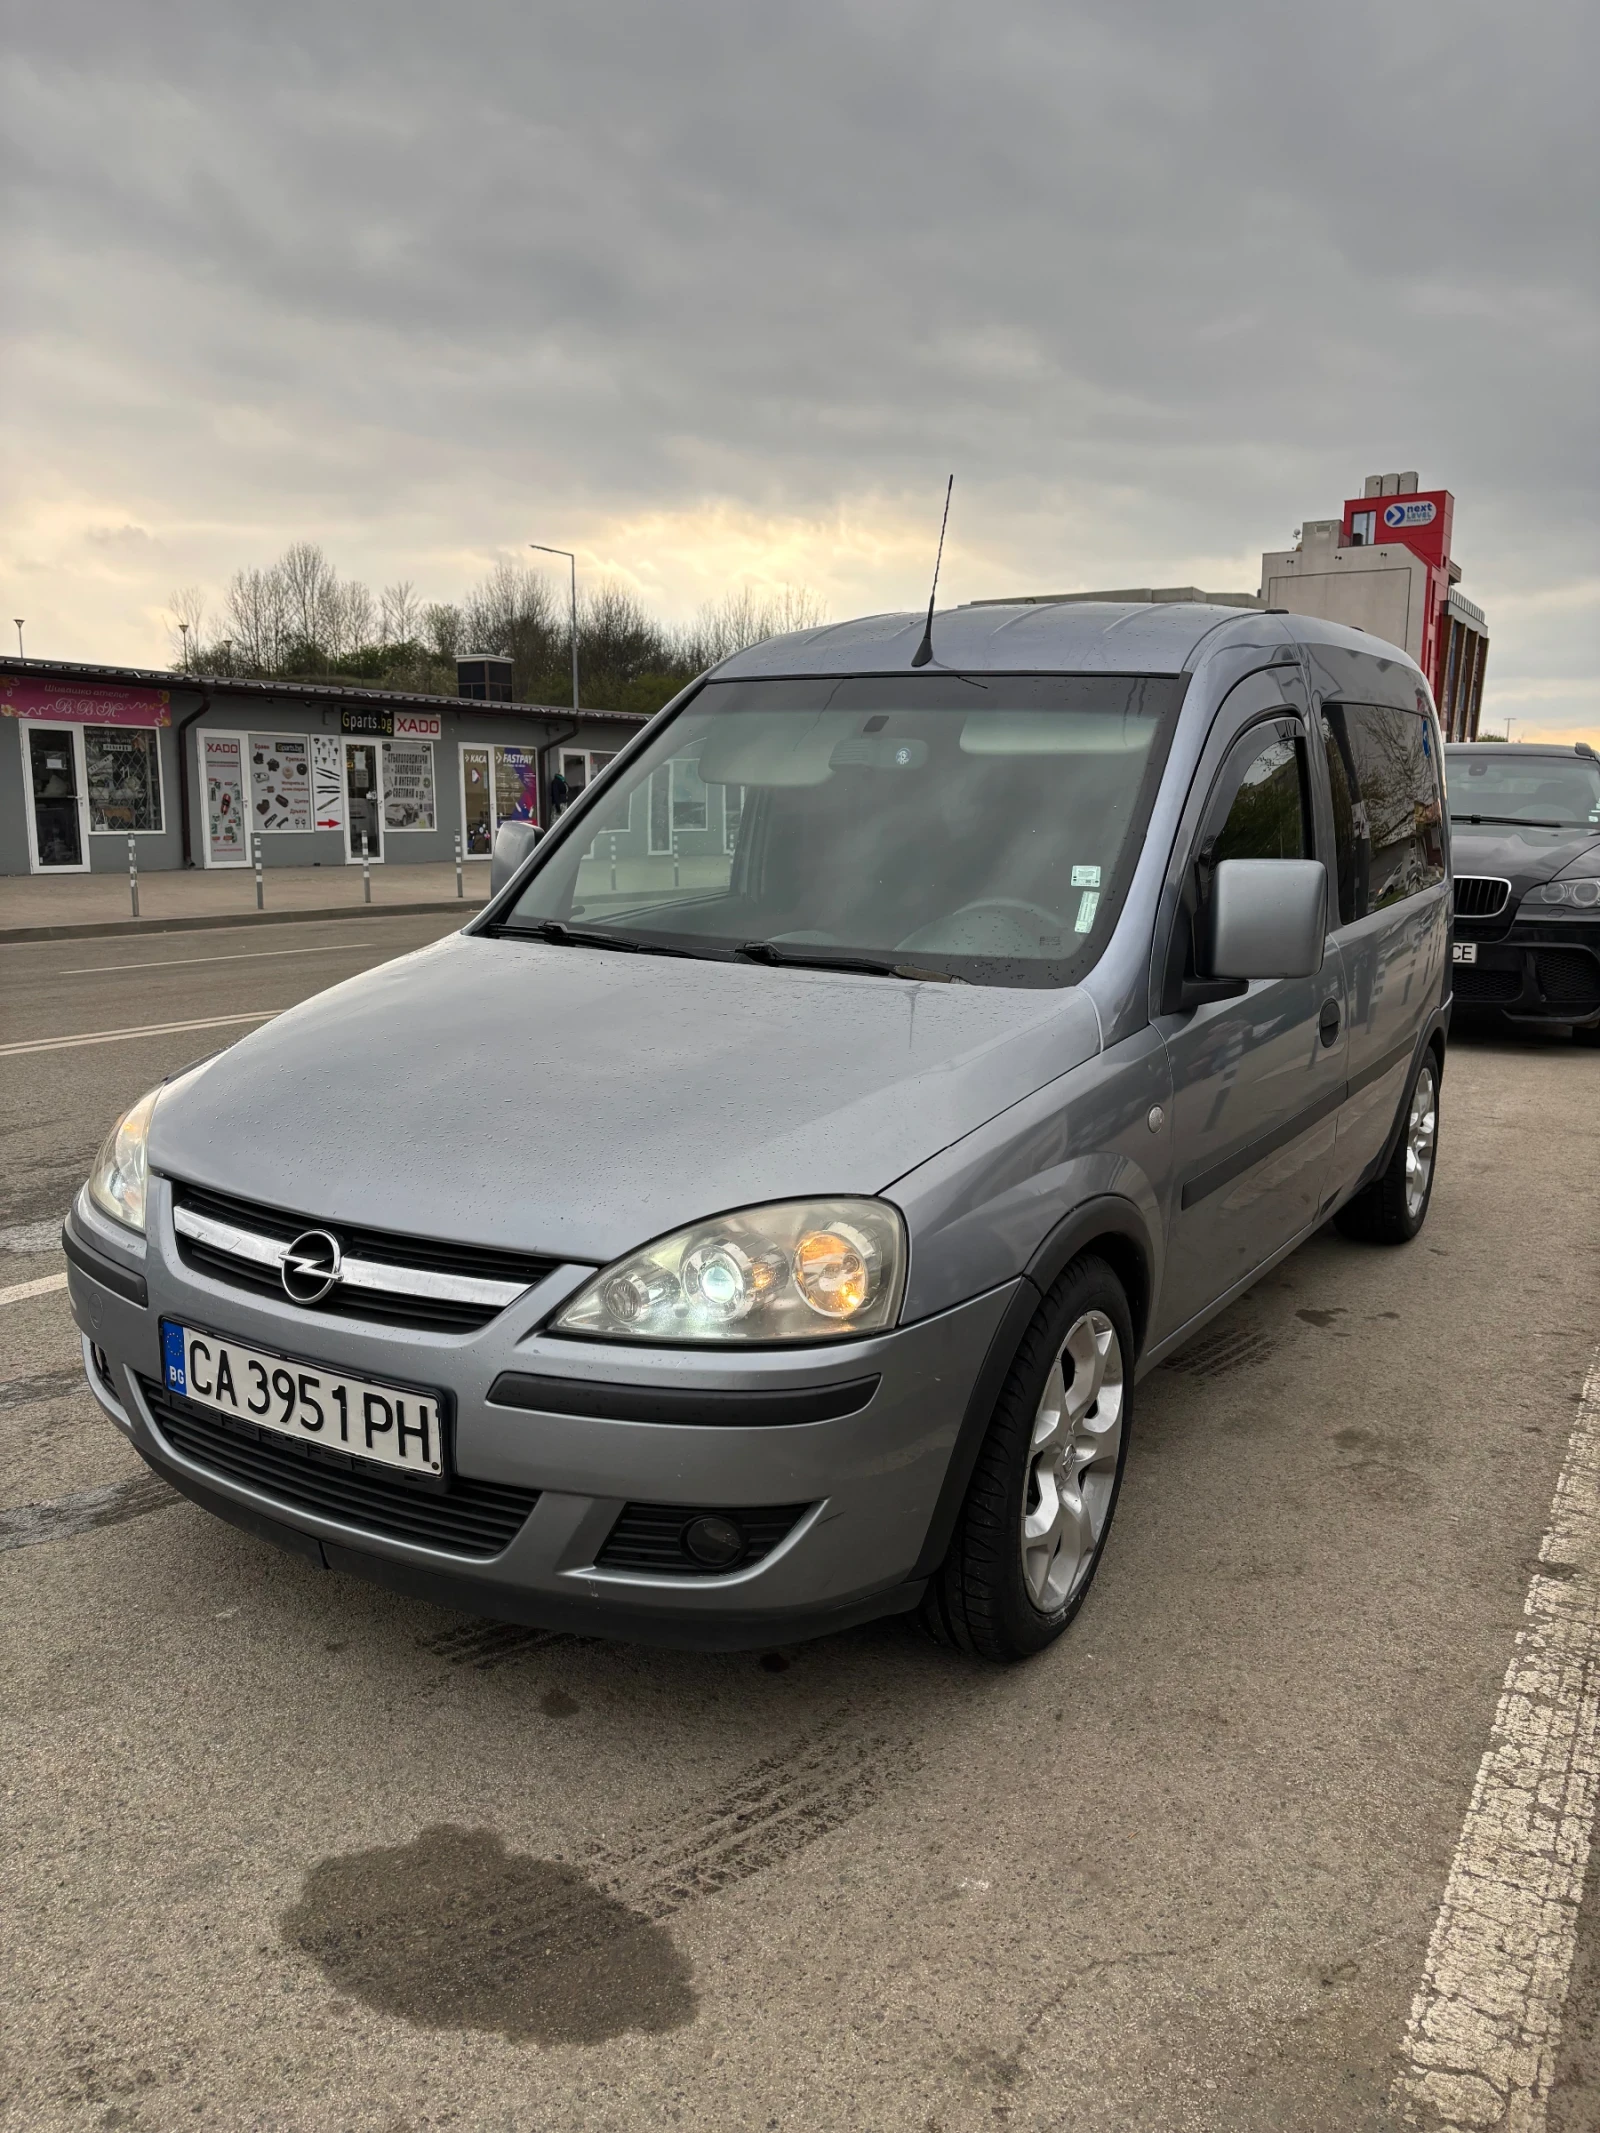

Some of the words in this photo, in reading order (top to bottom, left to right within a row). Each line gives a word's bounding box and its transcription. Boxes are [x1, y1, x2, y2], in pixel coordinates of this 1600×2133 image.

[1407, 503, 1432, 512] next
[44, 684, 92, 696] Шивашко
[93, 690, 130, 699] ателие
[342, 712, 393, 734] Gparts.bg
[396, 717, 440, 734] XADO
[206, 743, 238, 754] XADO
[503, 753, 534, 764] FASTPAY
[169, 1365, 185, 1385] BG
[189, 1340, 238, 1406] CA
[248, 1360, 348, 1442] 3951
[363, 1392, 430, 1463] PH
